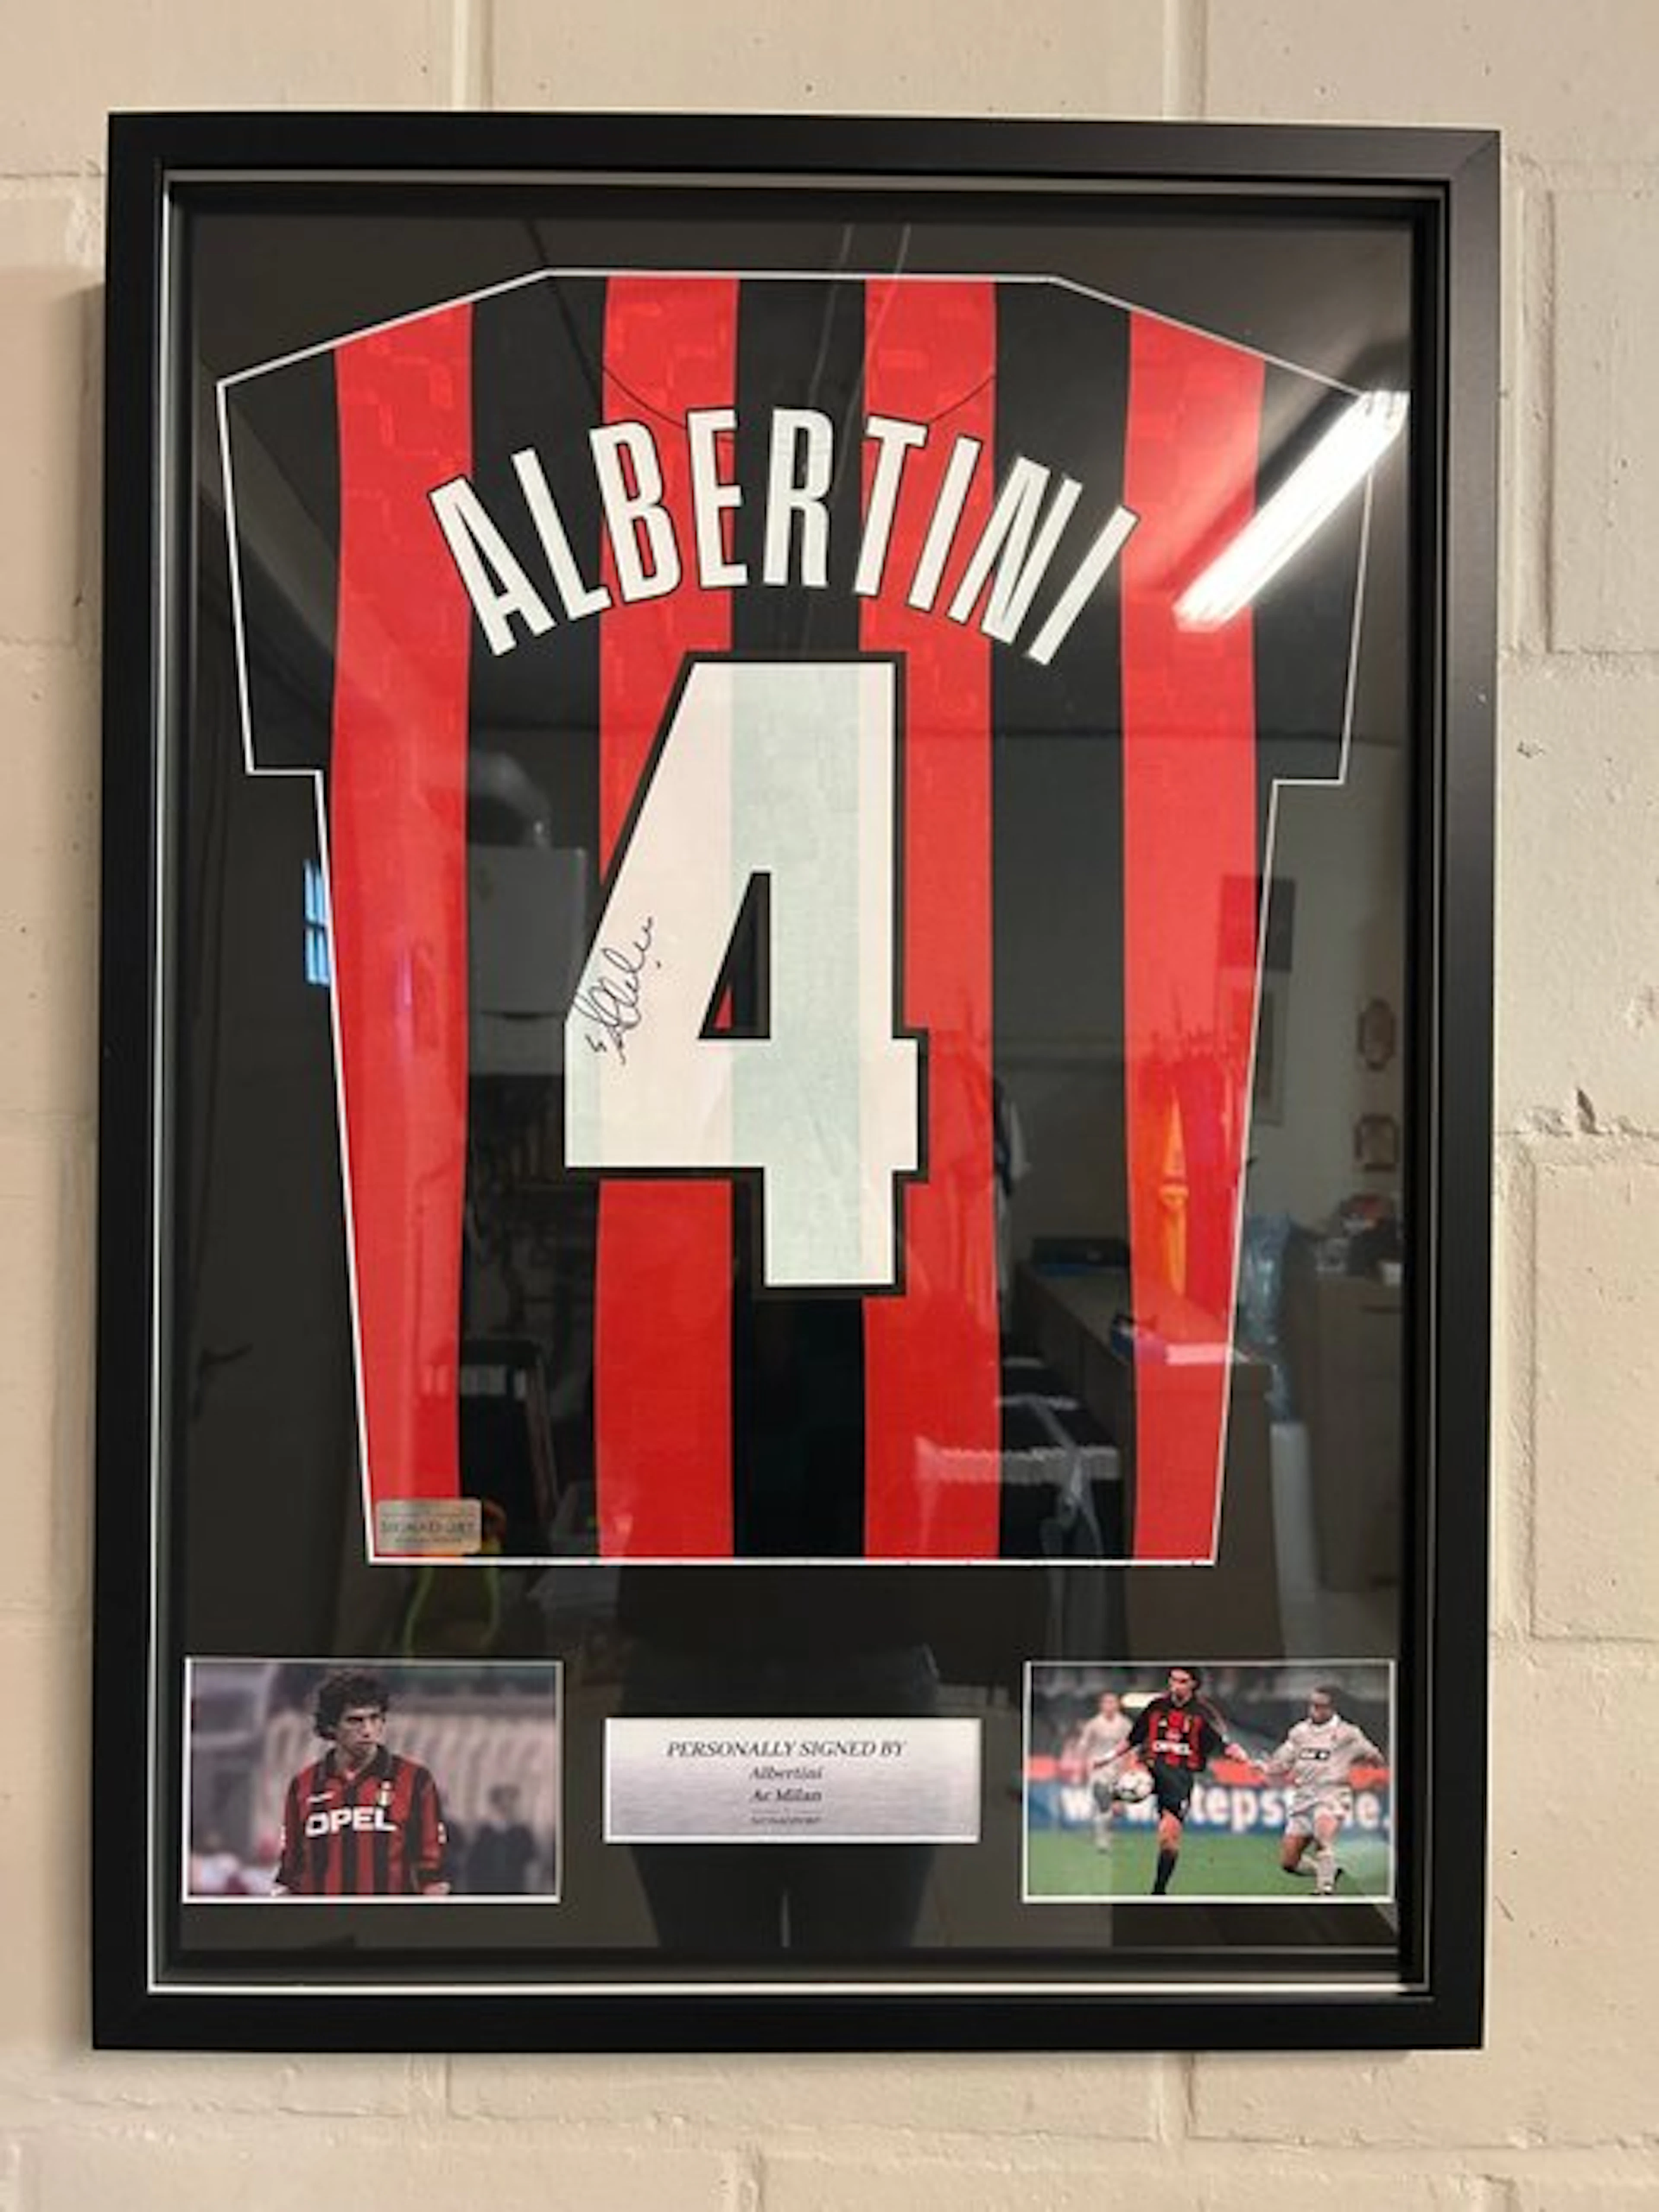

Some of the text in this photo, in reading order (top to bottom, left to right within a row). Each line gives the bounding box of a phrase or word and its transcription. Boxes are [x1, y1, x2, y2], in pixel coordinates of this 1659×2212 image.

[429, 407, 1139, 667] ALBERTINI
[564, 661, 918, 1287] 4
[666, 1740, 907, 1758] PERSONALLY SIGNED BY
[748, 1765, 825, 1780] Albertini
[776, 1787, 822, 1802] Milan
[305, 1806, 397, 1838] OPEL
